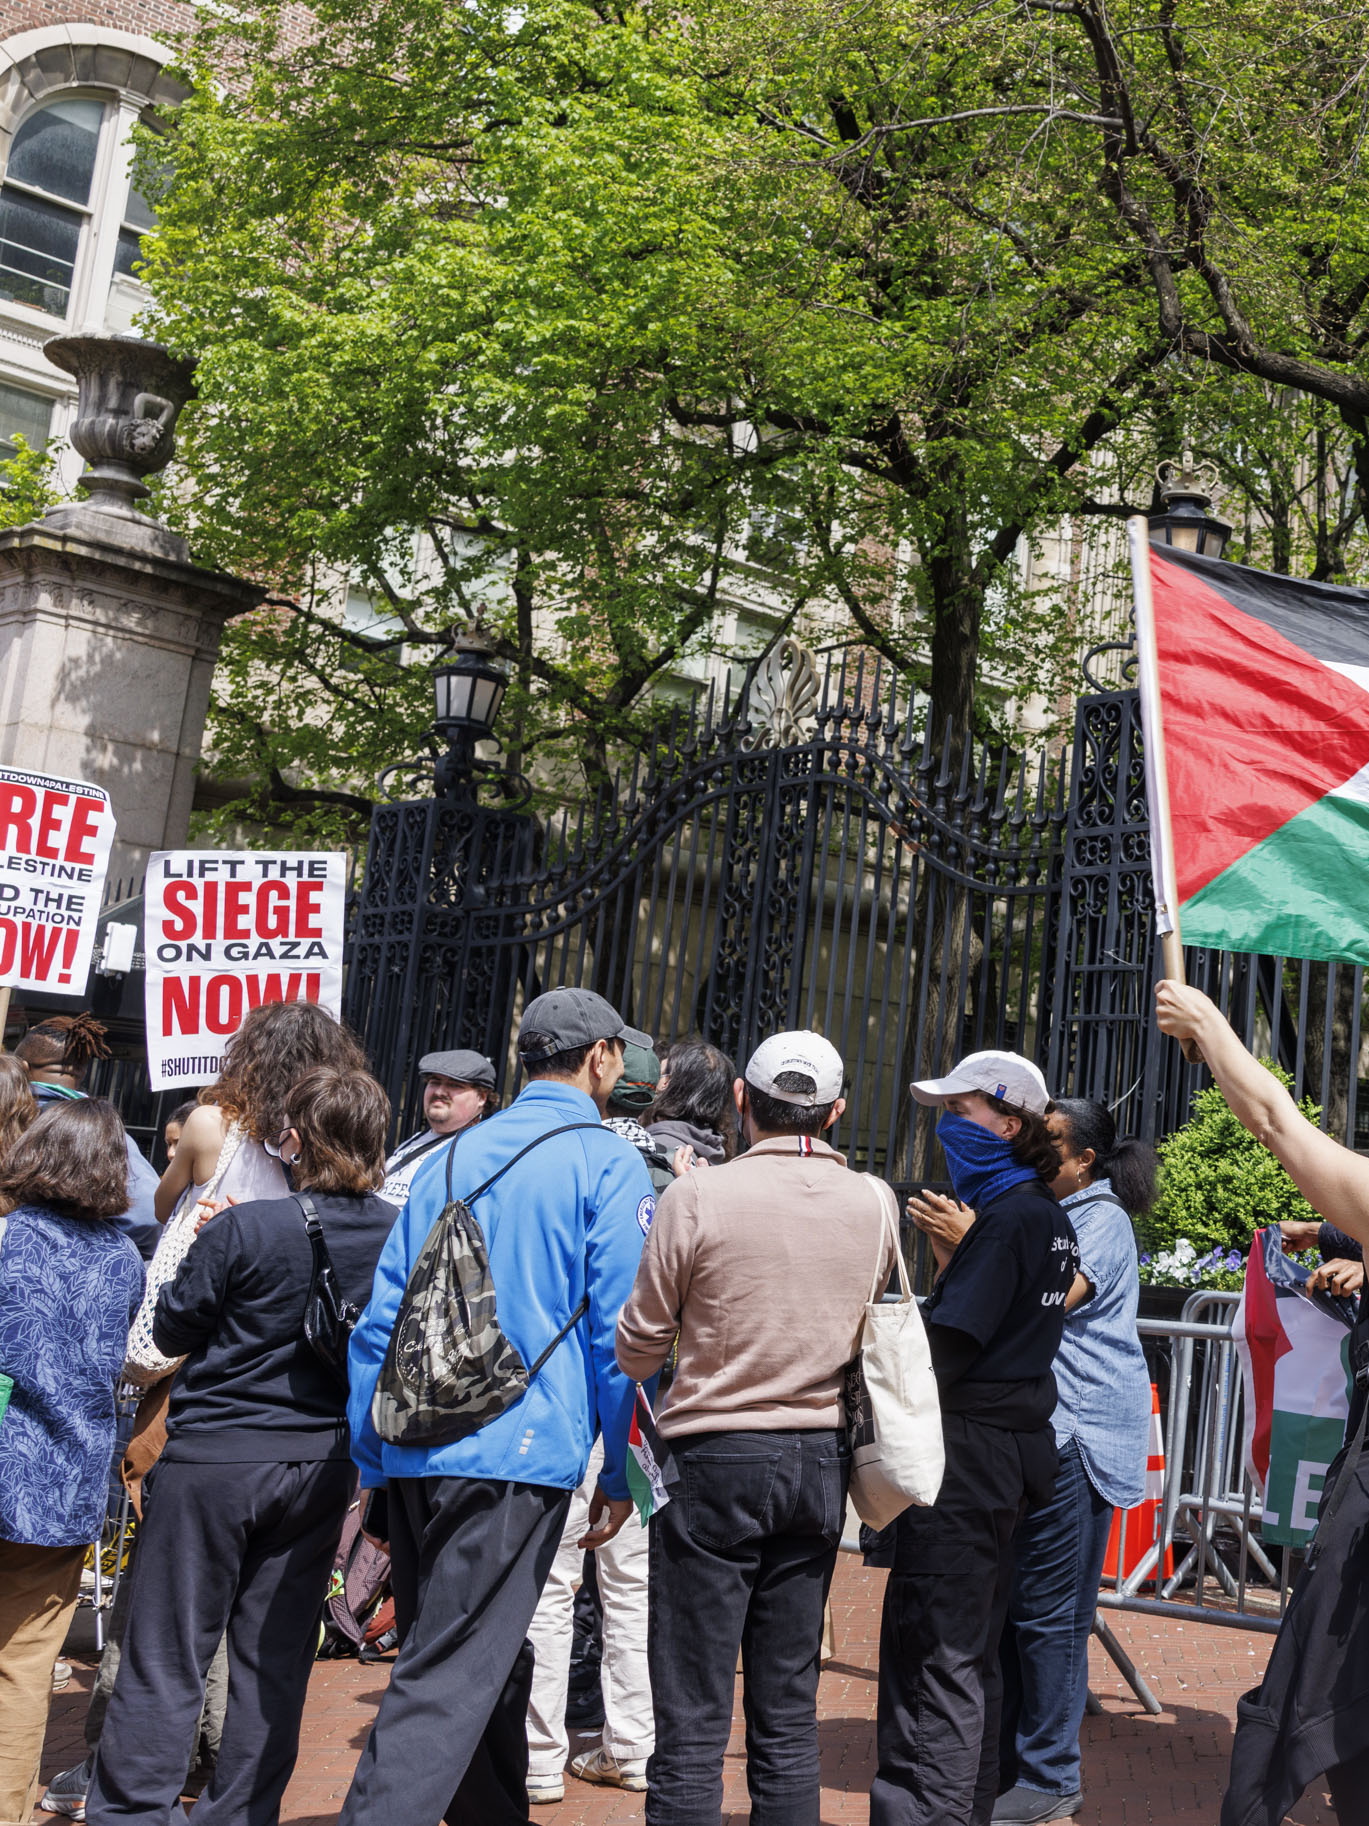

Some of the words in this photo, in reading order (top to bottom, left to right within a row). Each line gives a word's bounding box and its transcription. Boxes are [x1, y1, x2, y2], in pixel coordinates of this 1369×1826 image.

[163, 859, 245, 878] LIFT
[255, 859, 328, 878] THE
[30, 887, 86, 914] THE
[161, 880, 324, 941] SIEGE
[157, 943, 212, 962] ON
[223, 941, 329, 961] GAZA
